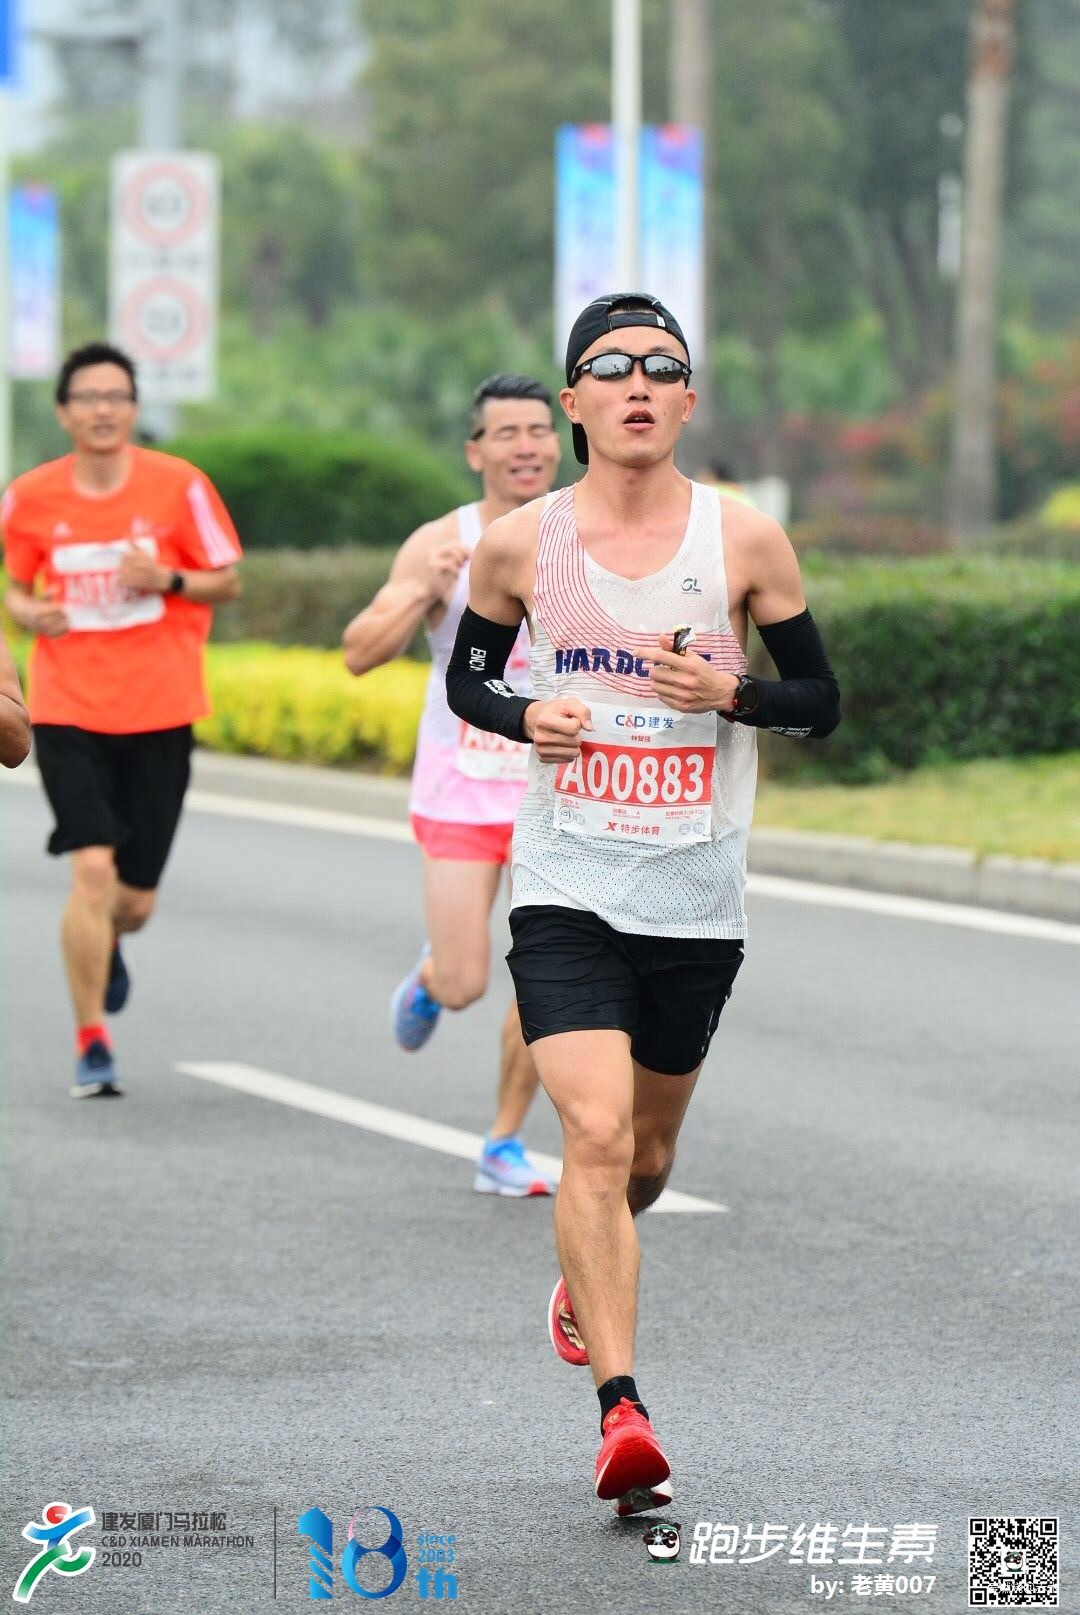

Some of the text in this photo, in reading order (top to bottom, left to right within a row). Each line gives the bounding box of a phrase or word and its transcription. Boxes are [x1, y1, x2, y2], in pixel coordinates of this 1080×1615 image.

[615, 714, 675, 730] C&D 建发
[559, 750, 705, 804] A00883
[620, 822, 661, 837] 特步体育
